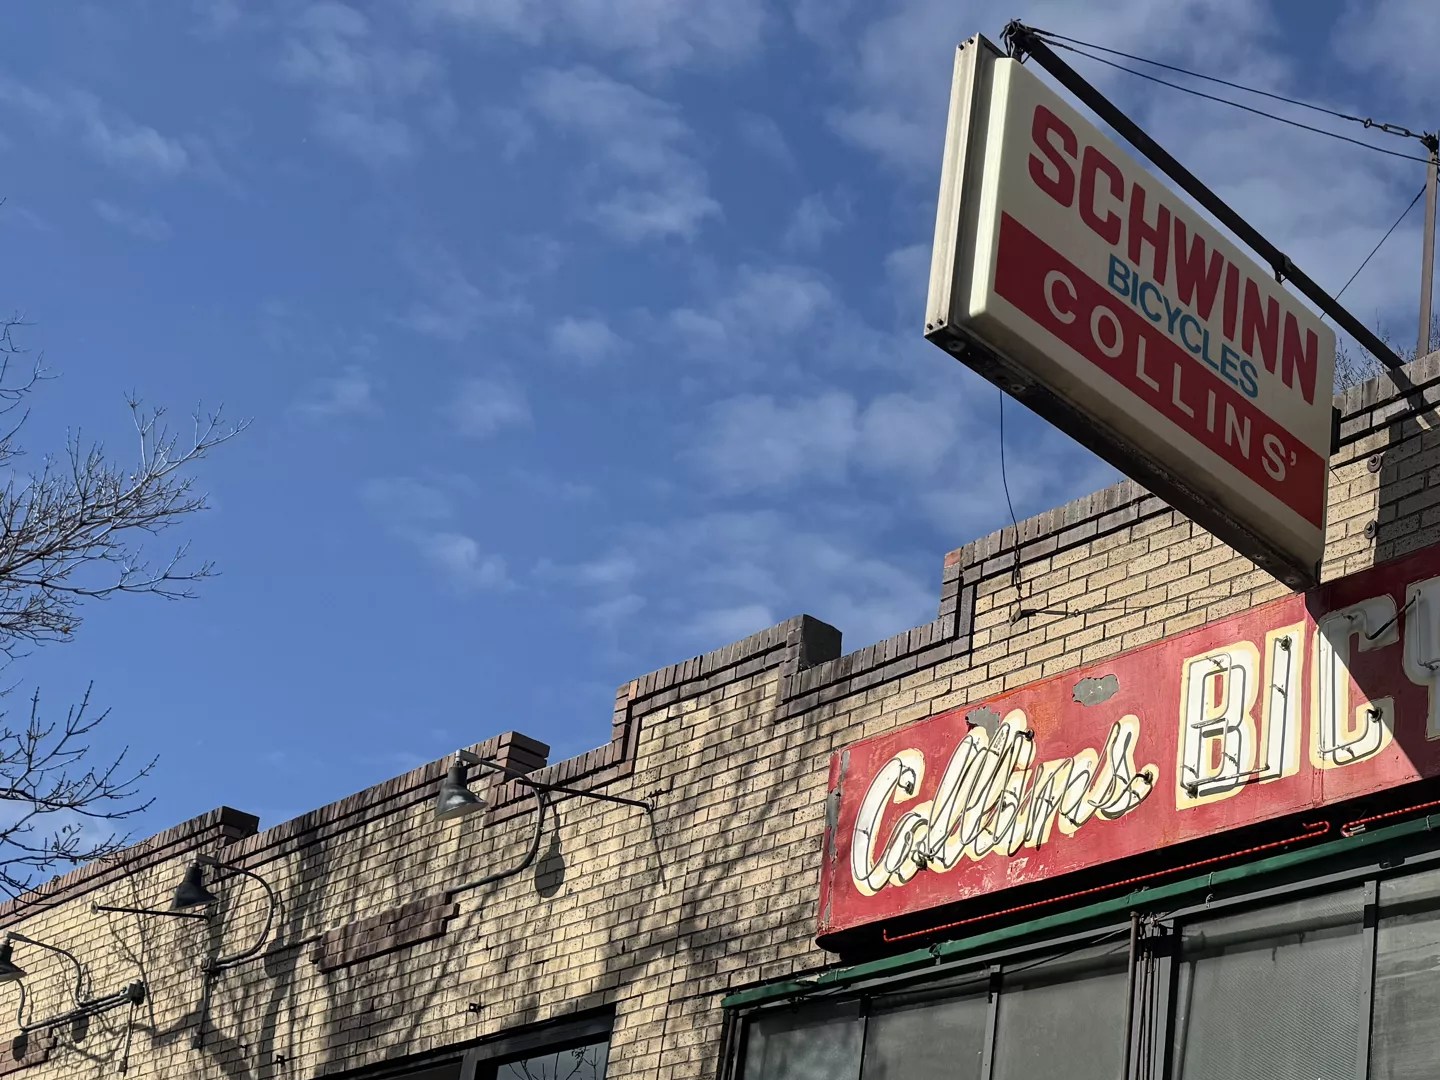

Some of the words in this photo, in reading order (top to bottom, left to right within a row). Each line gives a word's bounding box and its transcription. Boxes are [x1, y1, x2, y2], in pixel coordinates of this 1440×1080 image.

[1027, 104, 1318, 406] SCHWINN
[1106, 252, 1259, 399] BICYCLES
[1043, 269, 1298, 483] COLLINS'
[850, 708, 1160, 896] Collins
